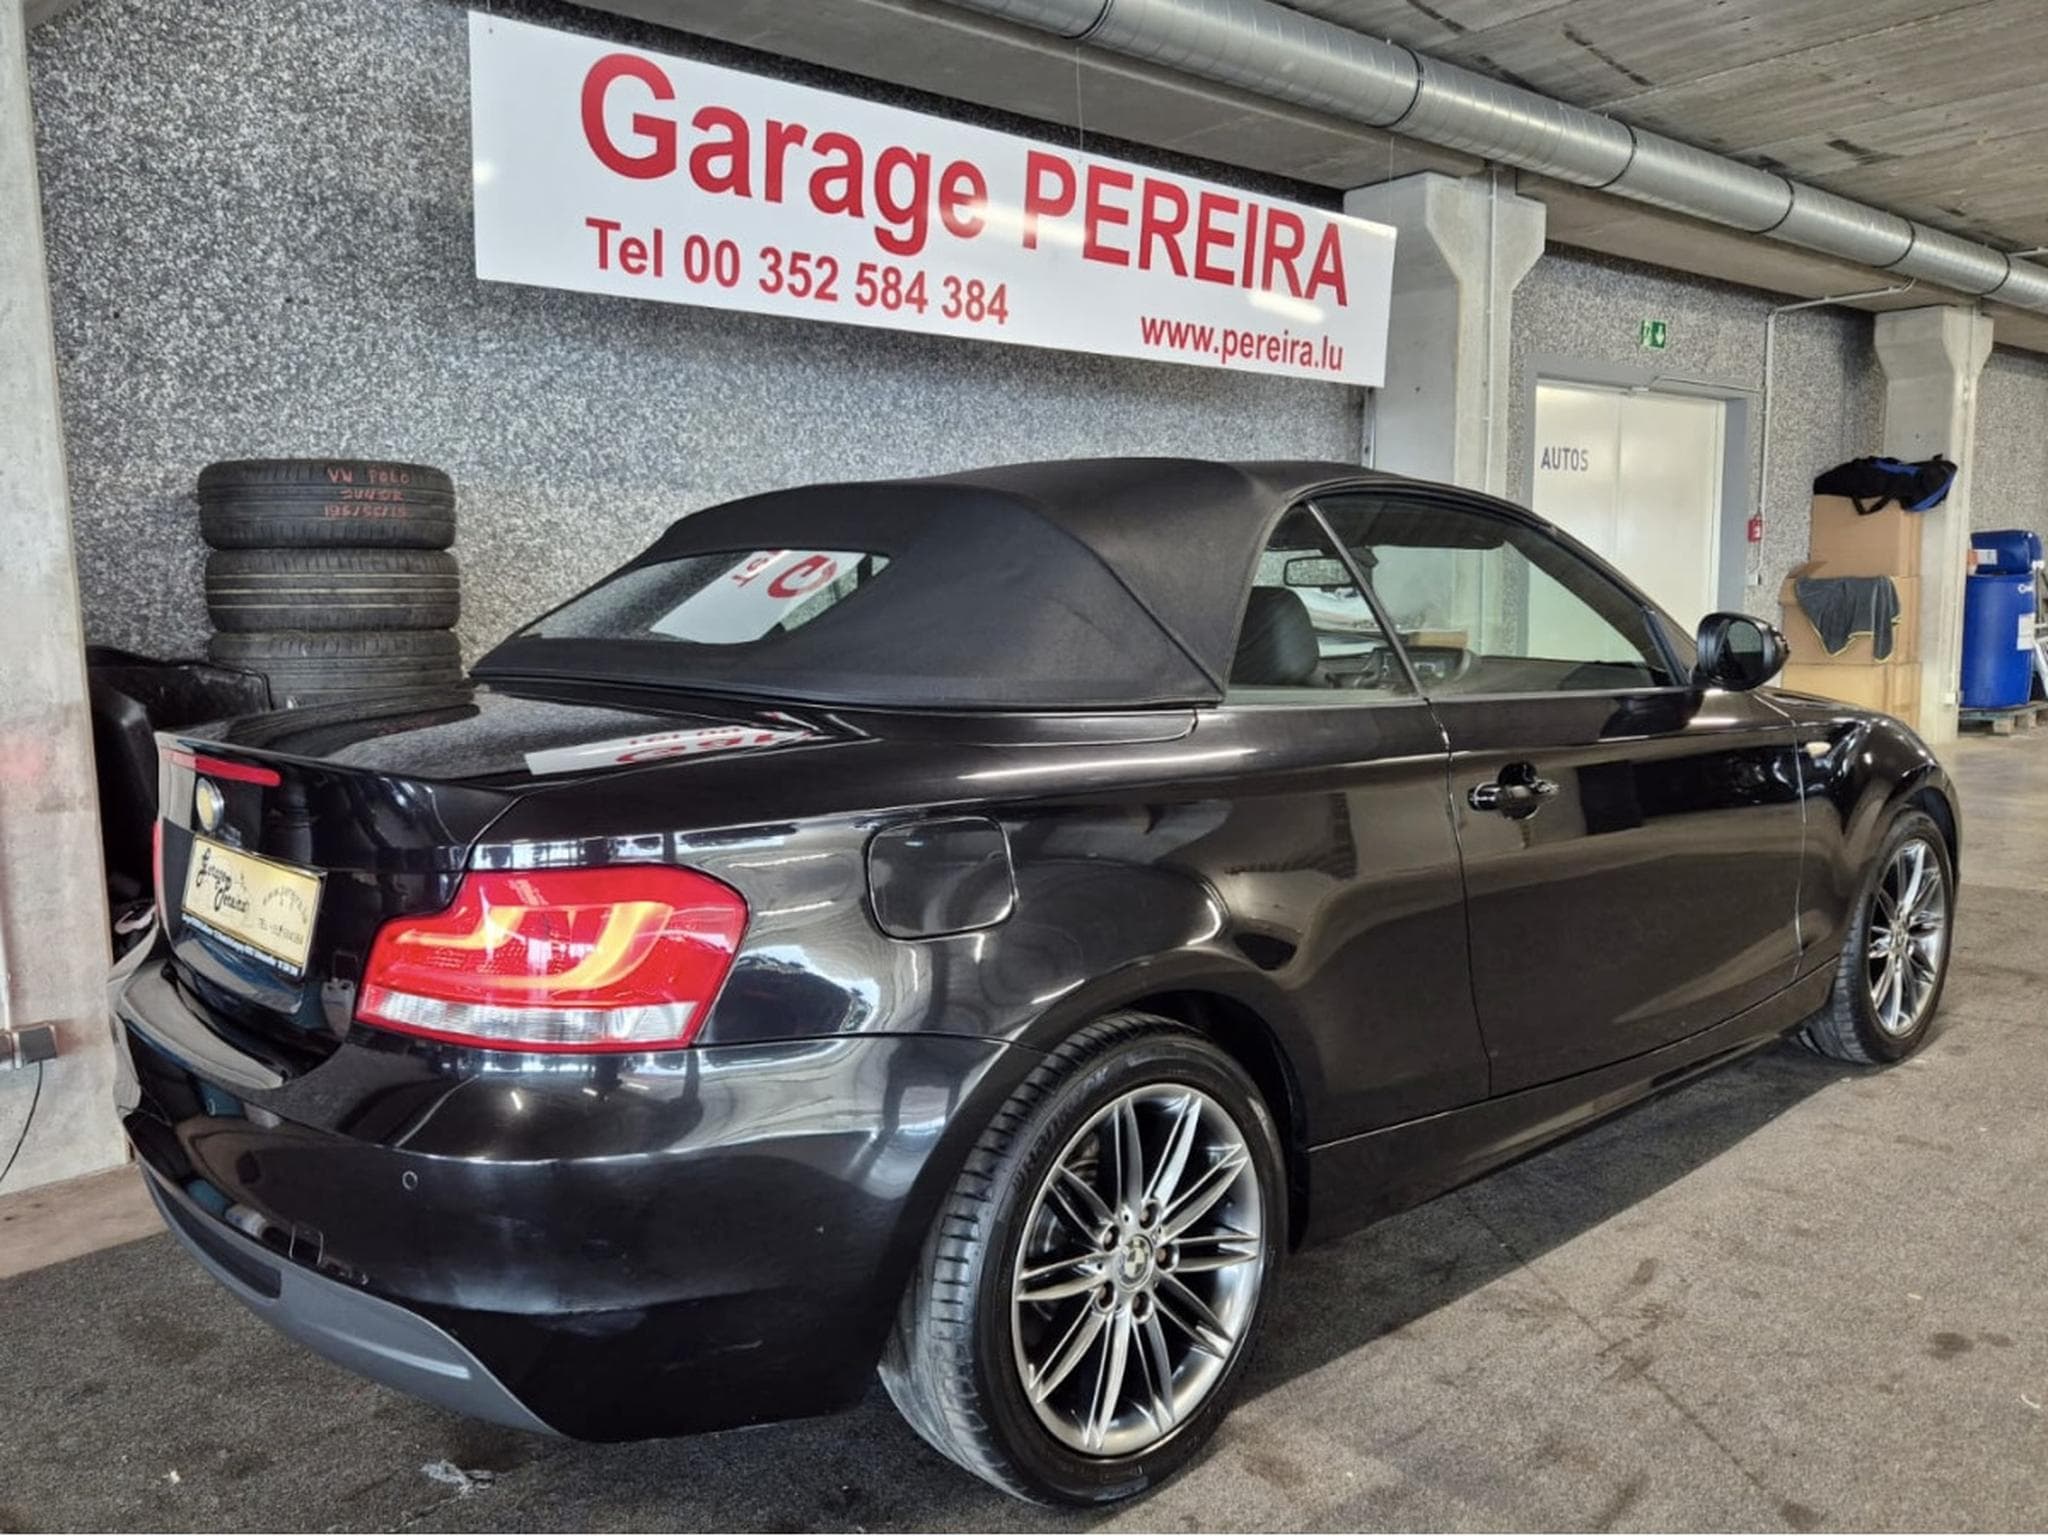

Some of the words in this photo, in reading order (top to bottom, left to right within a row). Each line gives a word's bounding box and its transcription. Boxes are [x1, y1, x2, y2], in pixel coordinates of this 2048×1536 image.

[580, 53, 987, 257] Garage
[1022, 150, 1348, 307] PEREIRA
[585, 216, 664, 278] Tel
[683, 234, 741, 289] 00
[759, 246, 840, 303] 352
[855, 262, 928, 314] 584
[942, 275, 1008, 325] 384
[1140, 316, 1343, 371] www.pereira.lu
[369, 468, 411, 484] POLO
[1541, 447, 1589, 471] AUTOS
